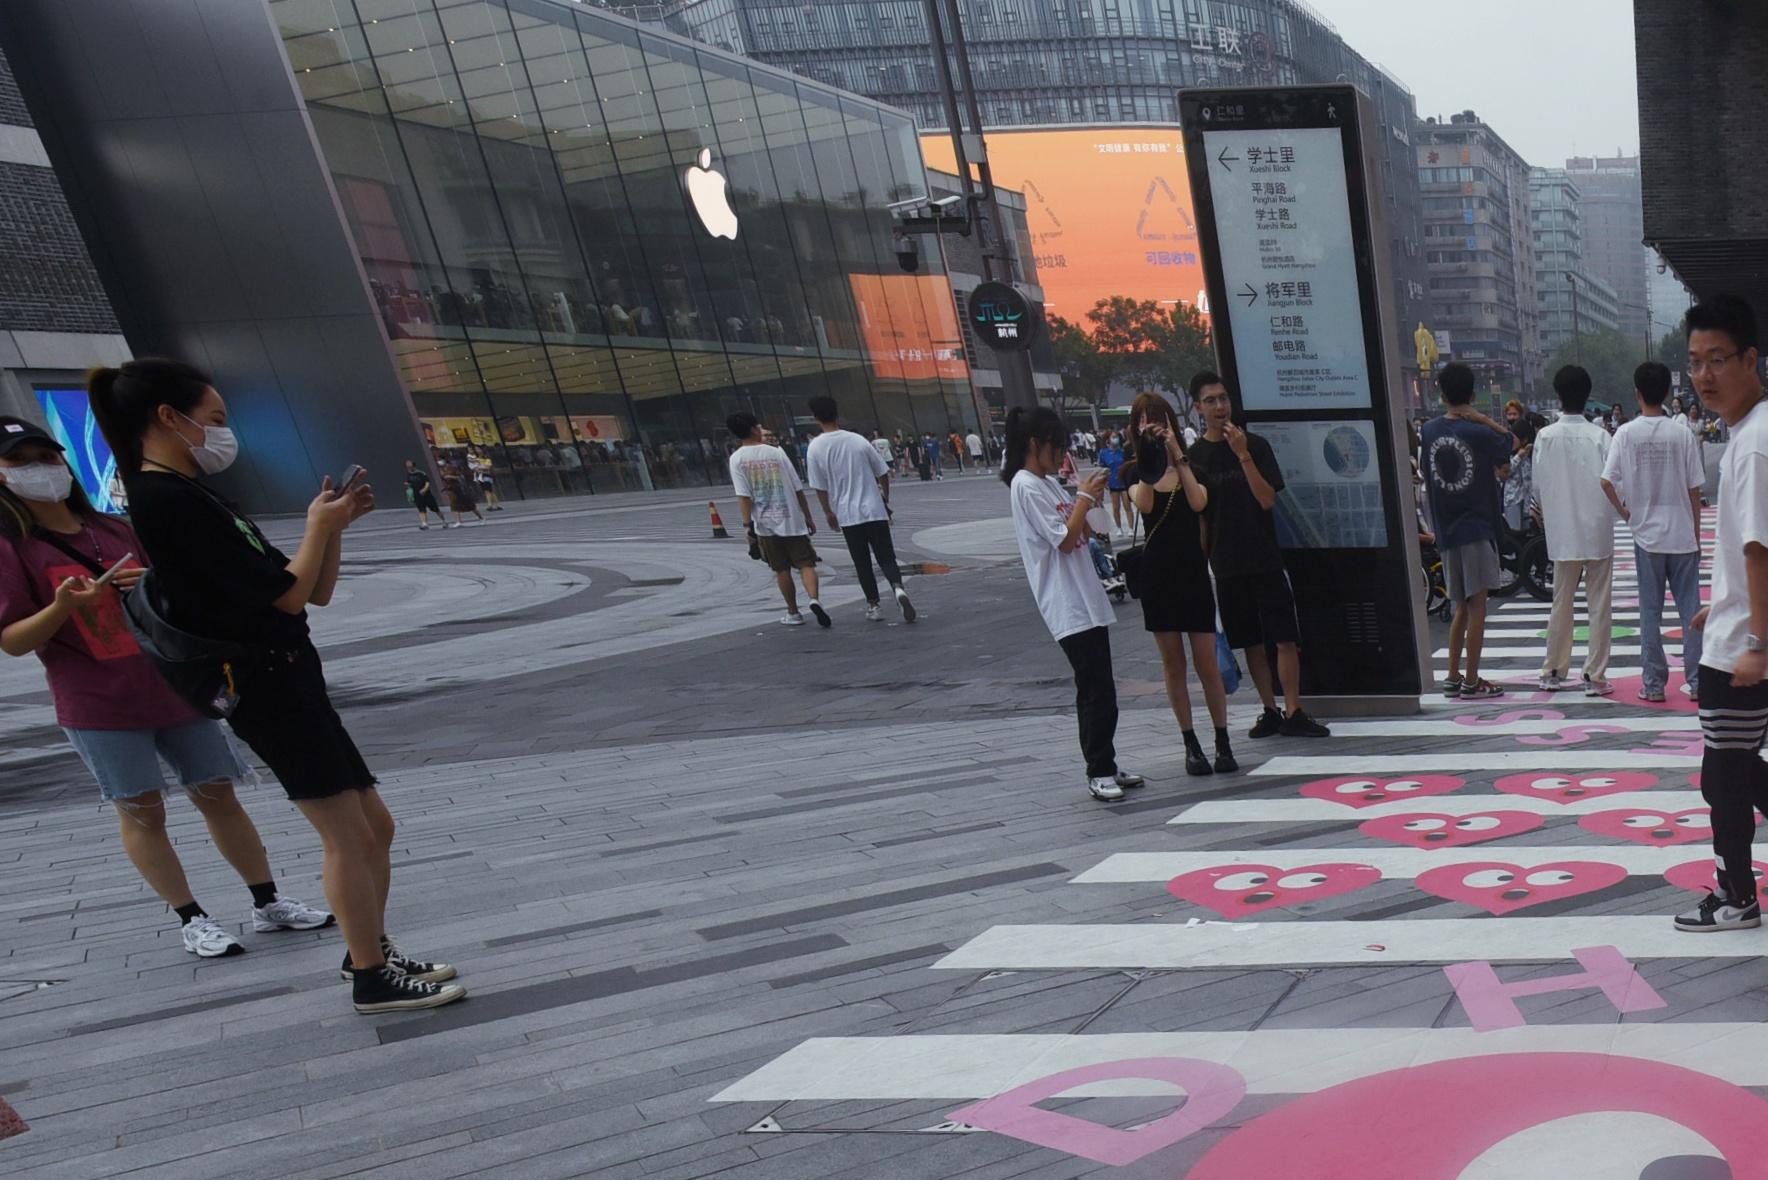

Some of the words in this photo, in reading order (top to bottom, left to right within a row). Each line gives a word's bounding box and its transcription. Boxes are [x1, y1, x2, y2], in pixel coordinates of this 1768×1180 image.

[1189, 23, 1242, 55] 工联
[1247, 146, 1296, 165] 学士里
[1249, 165, 1272, 174] Xueshi
[1273, 164, 1291, 173] Block
[1251, 182, 1287, 195] 平海路
[1252, 196, 1278, 205] Pinghai
[1279, 195, 1296, 203] Road
[1255, 208, 1290, 221] 学士路
[1257, 222, 1279, 230] Xueshi
[1280, 222, 1297, 230] Road
[1265, 281, 1312, 299] 将军里
[1267, 300, 1295, 308] Jiangjun
[1270, 315, 1304, 328] 仁和路
[1272, 341, 1306, 352] 邮电路
